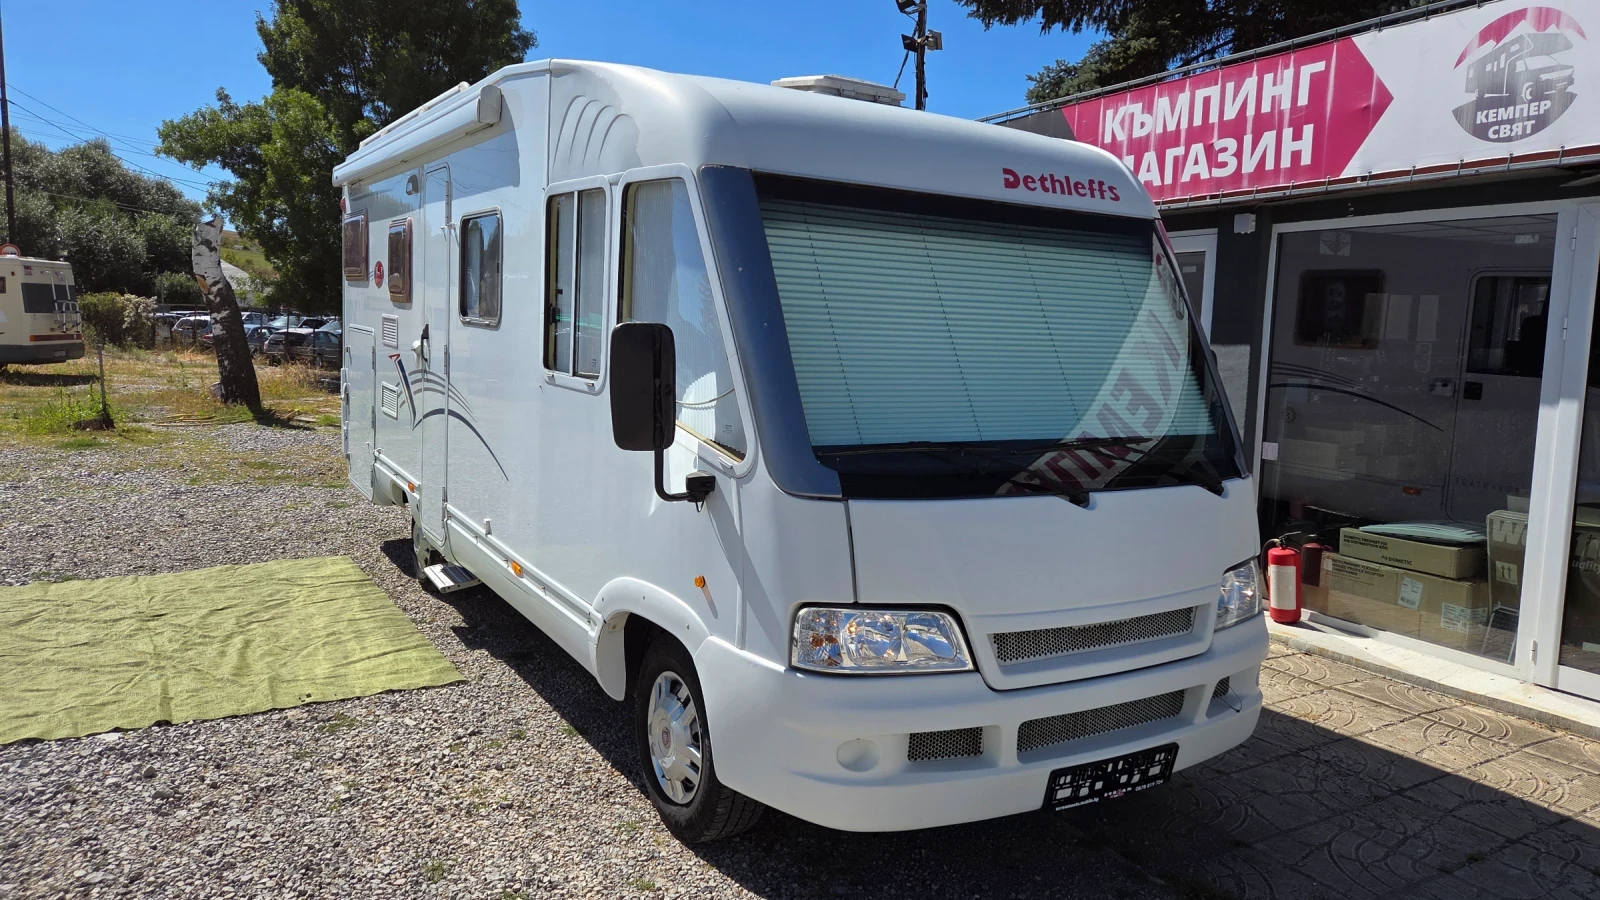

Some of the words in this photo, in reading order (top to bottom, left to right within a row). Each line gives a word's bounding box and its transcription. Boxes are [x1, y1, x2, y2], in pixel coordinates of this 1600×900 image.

[1104, 61, 1326, 144] КЪМПИНГ
[1475, 100, 1552, 124] КЕМПЕР
[1488, 120, 1536, 139] СВЯТ
[1002, 167, 1121, 202] Dethleffs
[1388, 556, 1413, 566] DOMETIC
